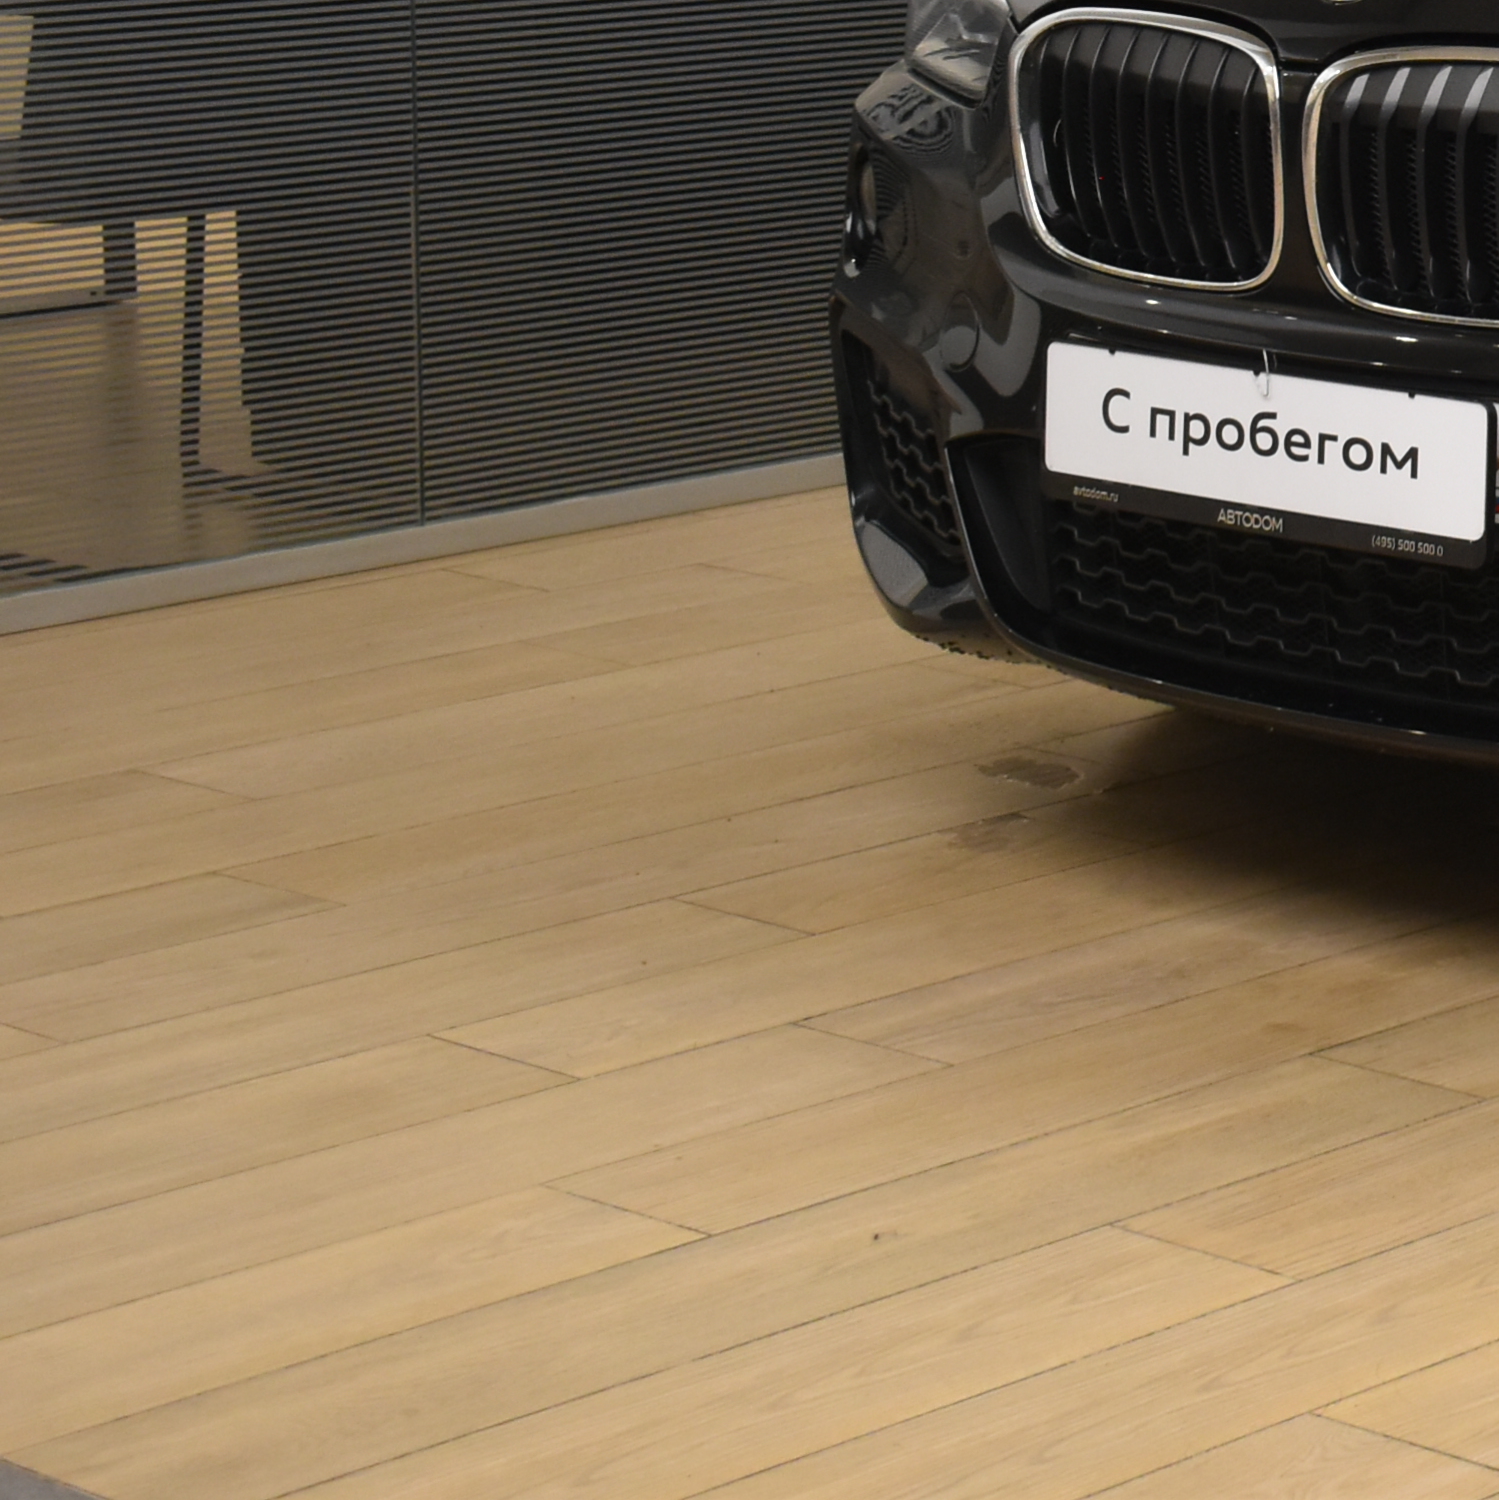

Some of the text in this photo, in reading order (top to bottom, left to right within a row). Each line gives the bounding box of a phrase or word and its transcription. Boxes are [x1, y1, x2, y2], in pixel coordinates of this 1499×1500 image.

[1101, 387, 1420, 480] С пробегом
[1073, 485, 1119, 503] avtodom.ru
[1371, 534, 1444, 557] (495) 500 500 0
